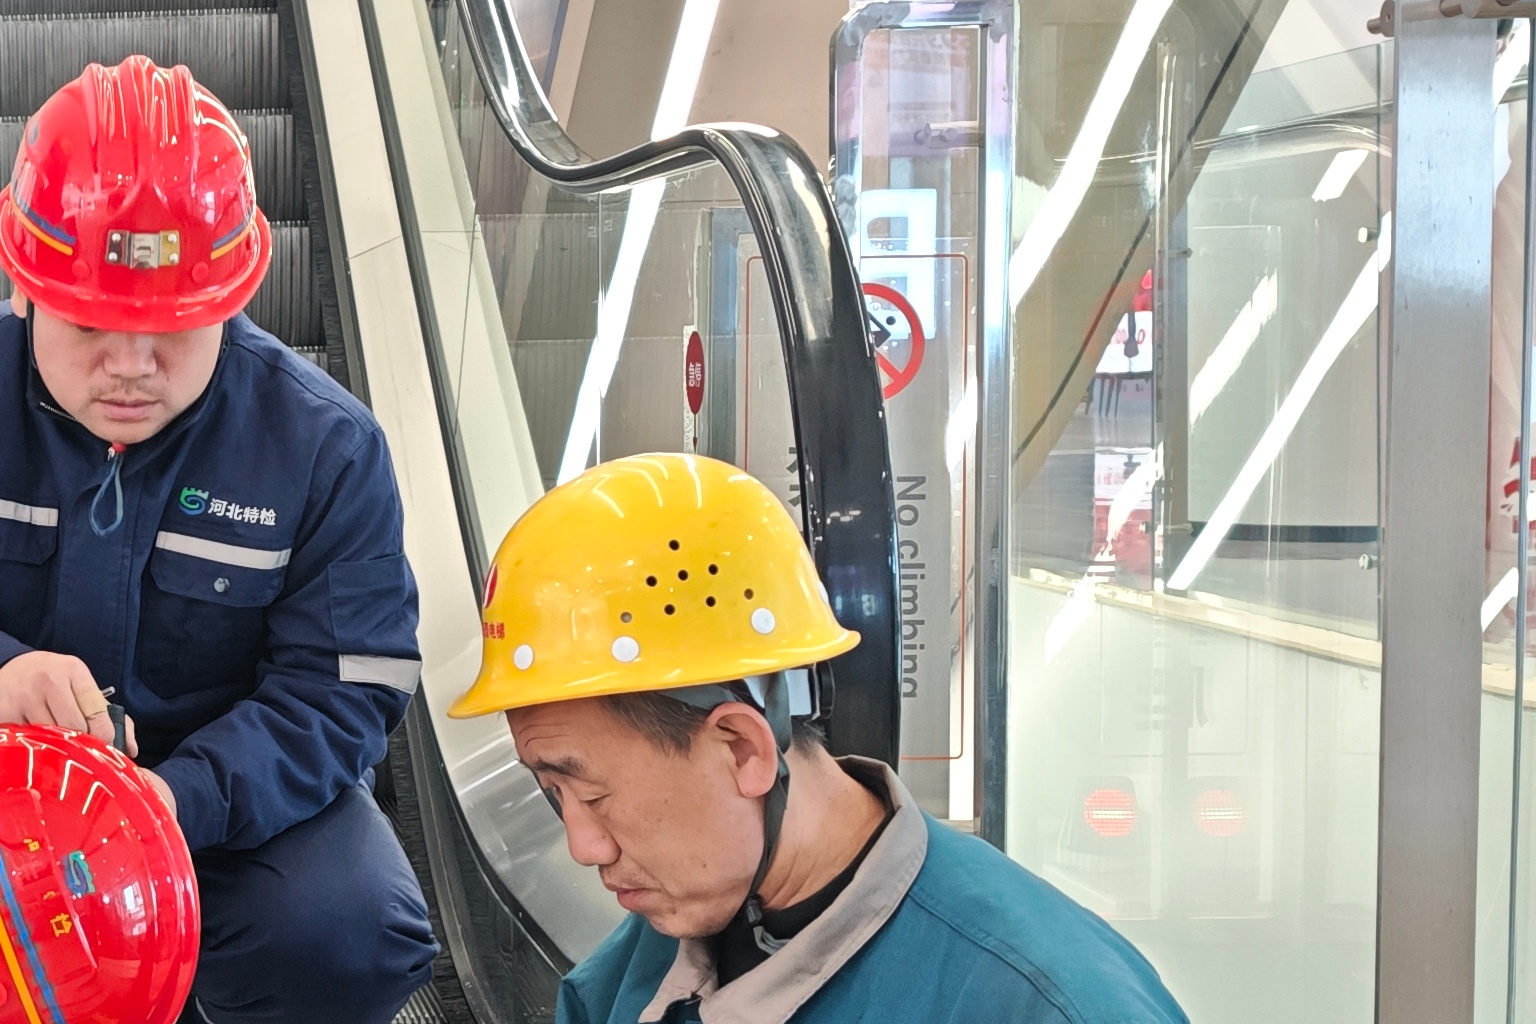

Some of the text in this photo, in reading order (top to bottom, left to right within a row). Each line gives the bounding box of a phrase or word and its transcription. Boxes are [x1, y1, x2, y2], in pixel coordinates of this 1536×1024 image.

[208, 498, 276, 525] 河北特检
[897, 476, 926, 526] No
